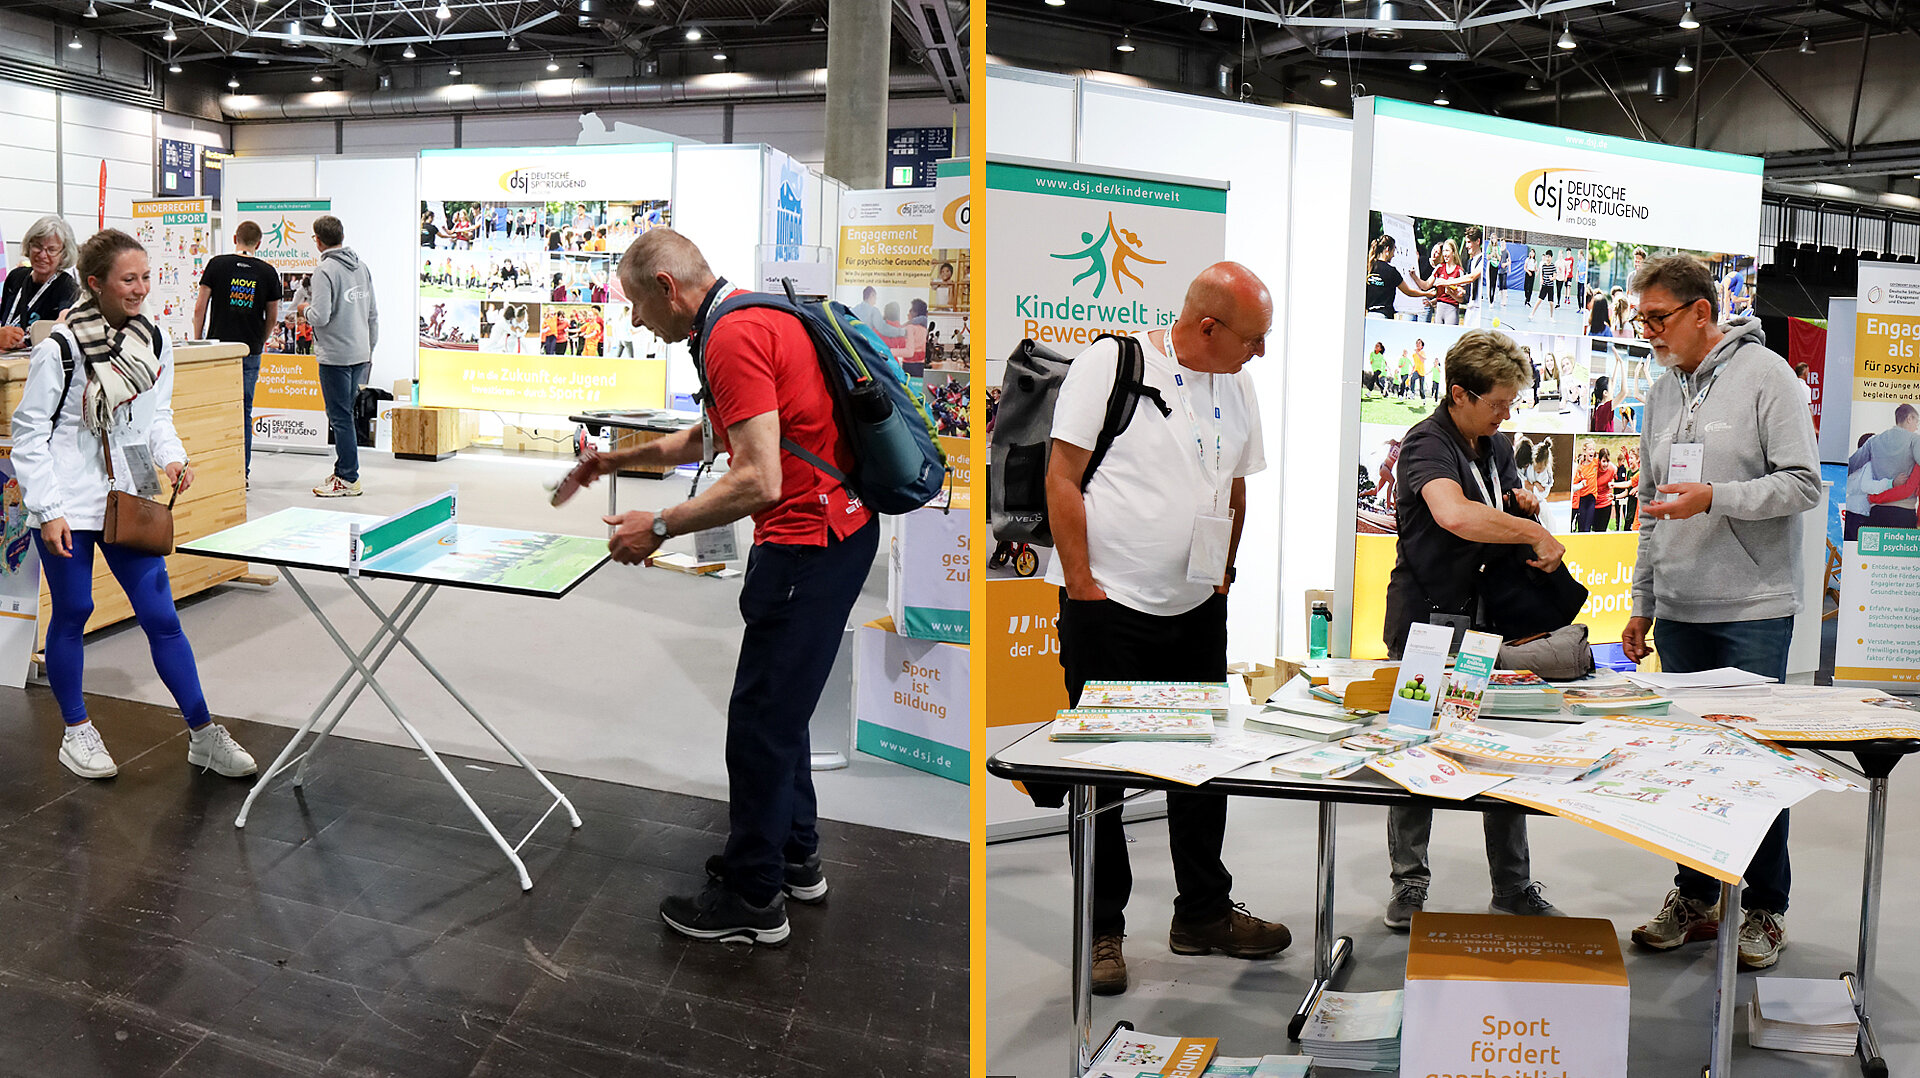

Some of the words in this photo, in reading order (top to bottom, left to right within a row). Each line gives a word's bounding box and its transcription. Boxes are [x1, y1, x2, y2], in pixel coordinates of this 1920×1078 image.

[1566, 134, 1608, 150] www.dsj.de
[530, 172, 570, 180] DEUTSCHE
[510, 170, 528, 194] dsj
[530, 180, 586, 189] SPORTJUGEND
[1036, 178, 1180, 202] www.dsj.de/kinderwelt
[1568, 180, 1626, 201] DEUTSCHE
[1534, 172, 1562, 222] dsj
[138, 202, 200, 213] KINDERRECHTE
[1567, 196, 1648, 220] SPORTJUGEND
[164, 214, 174, 223] IM
[177, 214, 205, 222] SPORT
[1577, 216, 1596, 226] DOSB
[848, 228, 918, 242] Engagement
[860, 243, 875, 255] als
[857, 258, 893, 266] psychische
[231, 278, 256, 288] MOVE
[231, 285, 255, 295] MOVE
[230, 292, 254, 302] MOVE
[230, 298, 254, 308] MOVE
[1016, 294, 1148, 324] Kinderwelt
[1156, 308, 1176, 326] ist
[1888, 340, 1914, 358] als
[270, 364, 302, 375] Zukunft
[1864, 360, 1880, 371] für
[500, 368, 550, 384] Zukunft
[569, 372, 616, 388] Jugend
[284, 386, 308, 396] Sport
[1890, 382, 1910, 390] junge
[550, 386, 584, 400] Sport
[1863, 392, 1897, 400] begleiten
[256, 416, 270, 438] dsj
[272, 420, 304, 428] DEUTSCHE
[272, 426, 317, 436] SPORTJUGEND
[1884, 532, 1904, 540] Finde
[1883, 544, 1918, 552] psychisch
[1587, 569, 1608, 586] der
[1870, 588, 1903, 596] Gesundheit
[1034, 614, 1047, 628] In
[1868, 622, 1904, 630] Belastungen
[1868, 638, 1896, 646] Verstehe,
[1010, 642, 1034, 657] der
[902, 660, 940, 681] Sport
[912, 679, 928, 695] ist
[894, 692, 946, 719] Bildung
[880, 740, 952, 768] www.dsj.de
[1452, 932, 1505, 940] Sport
[1506, 940, 1574, 949] Jugend
[1464, 946, 1542, 956] Zukunft
[1482, 1015, 1550, 1040] Sport
[1471, 1041, 1560, 1065] fördert
